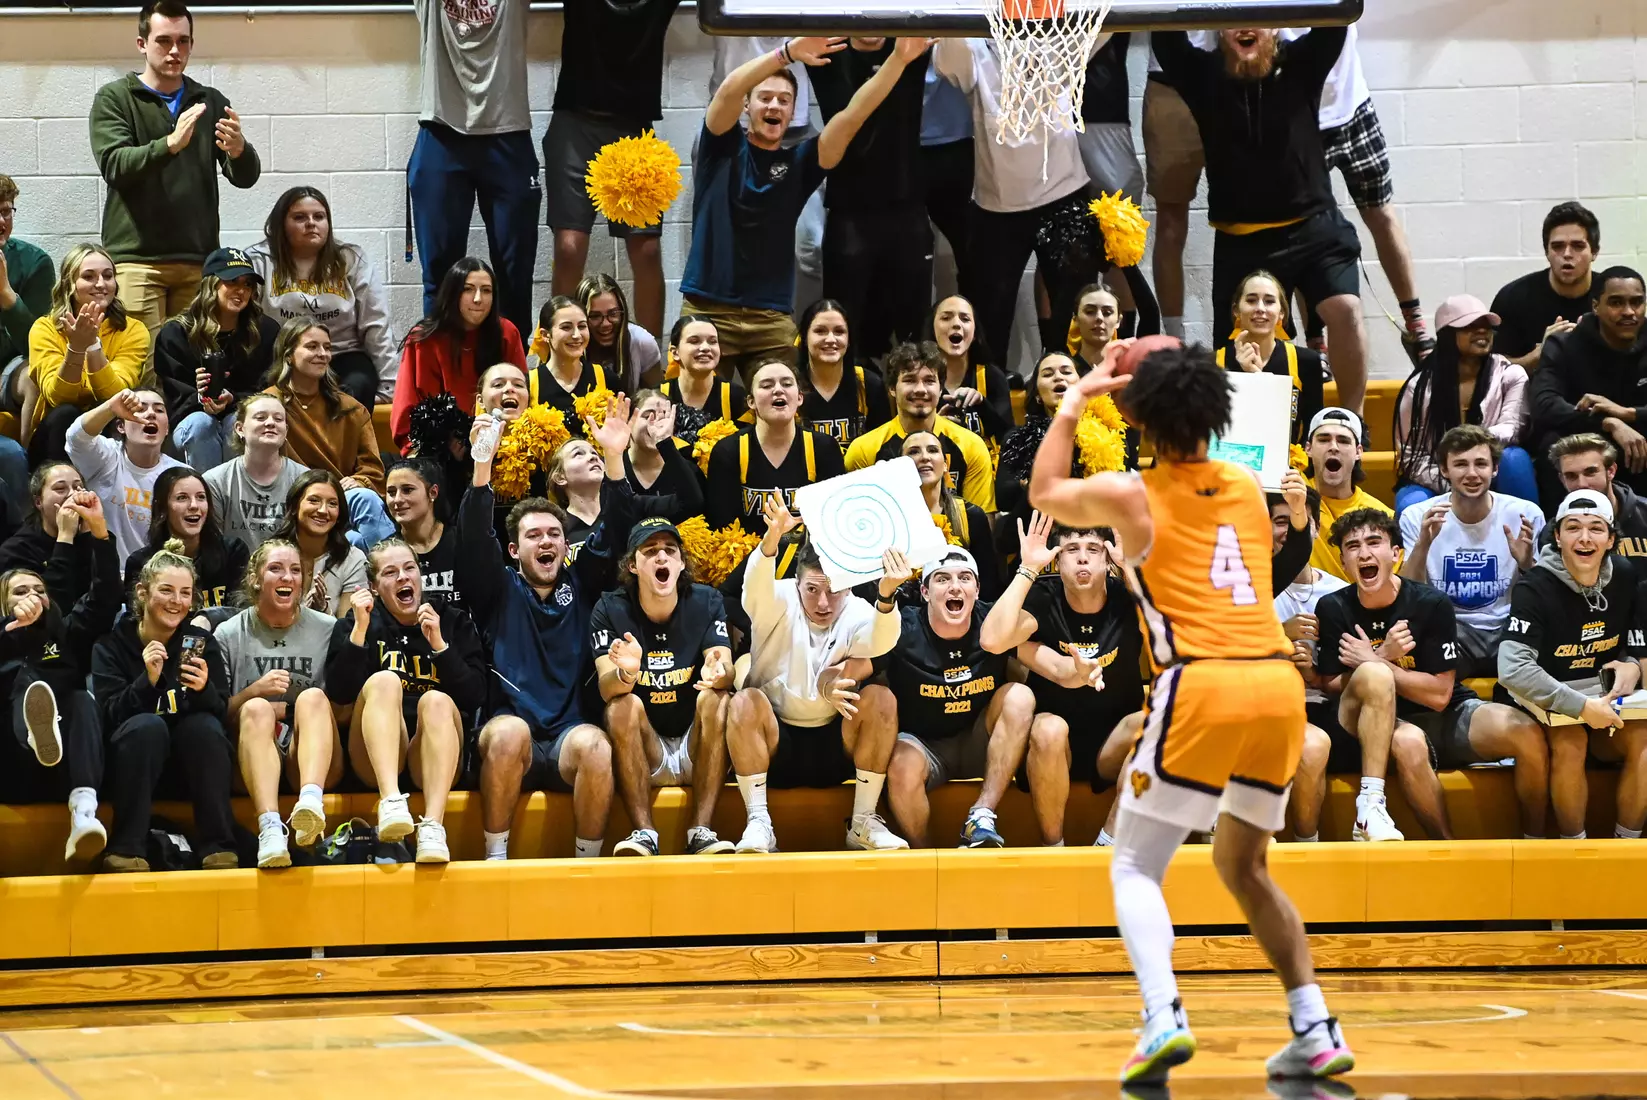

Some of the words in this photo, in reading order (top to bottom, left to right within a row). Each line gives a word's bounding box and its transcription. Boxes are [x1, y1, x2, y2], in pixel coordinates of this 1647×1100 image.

[1209, 524, 1259, 606] 4
[1455, 553, 1487, 562] PSAC
[1459, 572, 1481, 580] 2021
[714, 620, 728, 638] 23
[1508, 616, 1531, 634] RV
[1581, 625, 1605, 638] PSAC
[1554, 634, 1620, 657] CHAMPIONS
[1627, 629, 1647, 647] AM
[1441, 642, 1457, 660] 21
[254, 656, 312, 679] VILLE
[648, 656, 674, 666] PSAC
[1569, 657, 1596, 669] 2021
[944, 668, 972, 680] PSAC
[920, 676, 995, 699] CHAMPIONS
[650, 691, 677, 704] 2021
[944, 700, 971, 713] 2021
